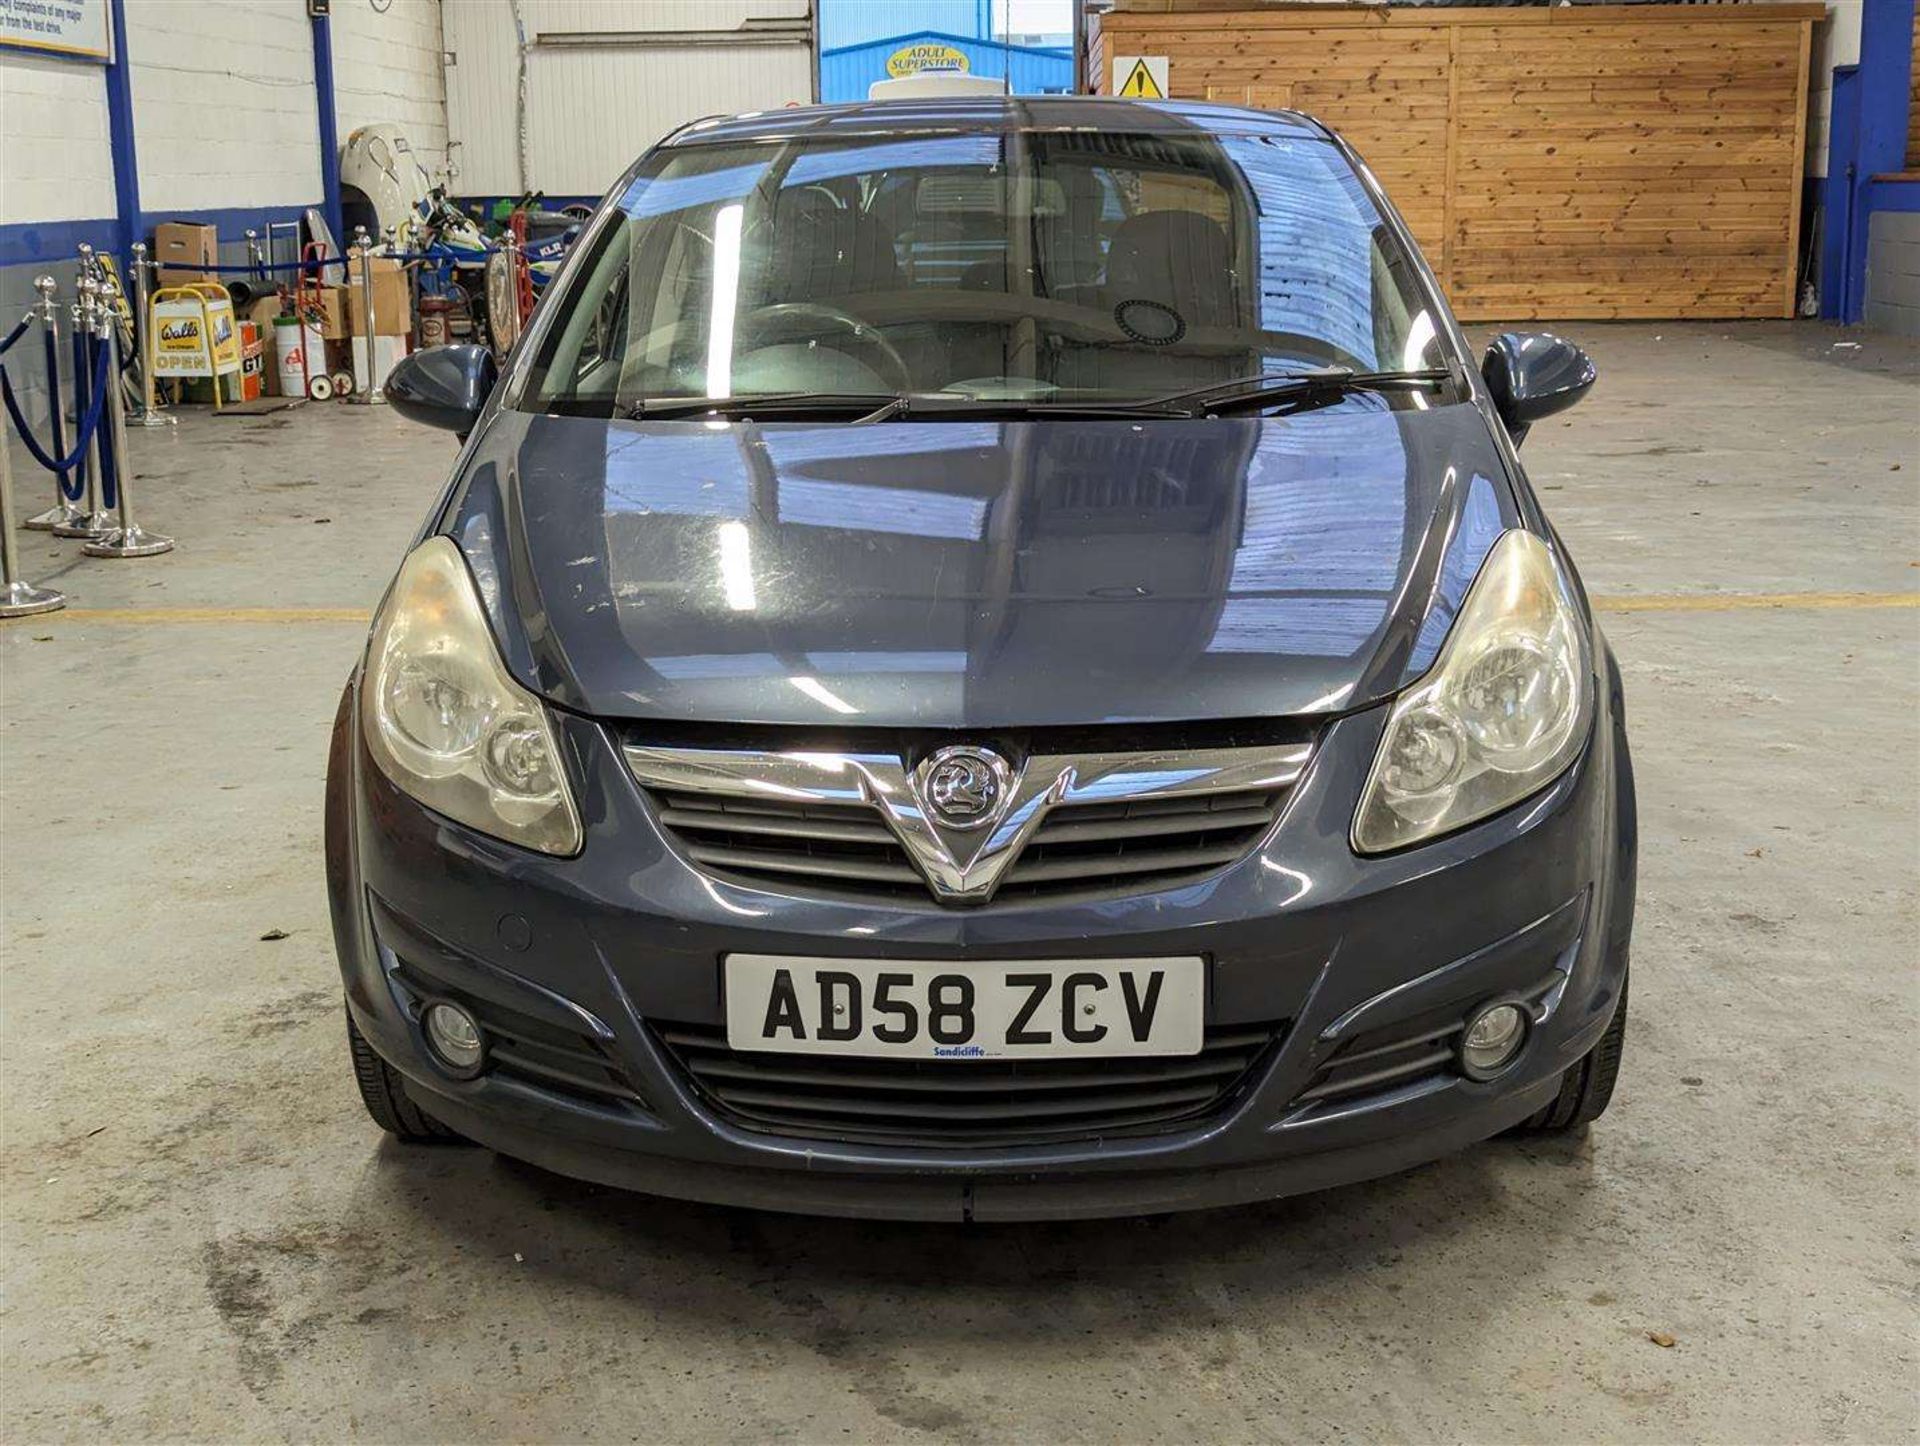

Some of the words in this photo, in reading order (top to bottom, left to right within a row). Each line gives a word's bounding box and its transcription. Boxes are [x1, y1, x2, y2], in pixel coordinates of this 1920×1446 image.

[908, 46, 945, 57] ADULT
[892, 57, 964, 69] SUPERSTORE
[539, 241, 562, 257] KLR
[156, 355, 206, 369] OPEN
[762, 968, 975, 1045] AD58
[1005, 971, 1165, 1045] ZCV
[933, 1046, 985, 1057] Sandicliffe
